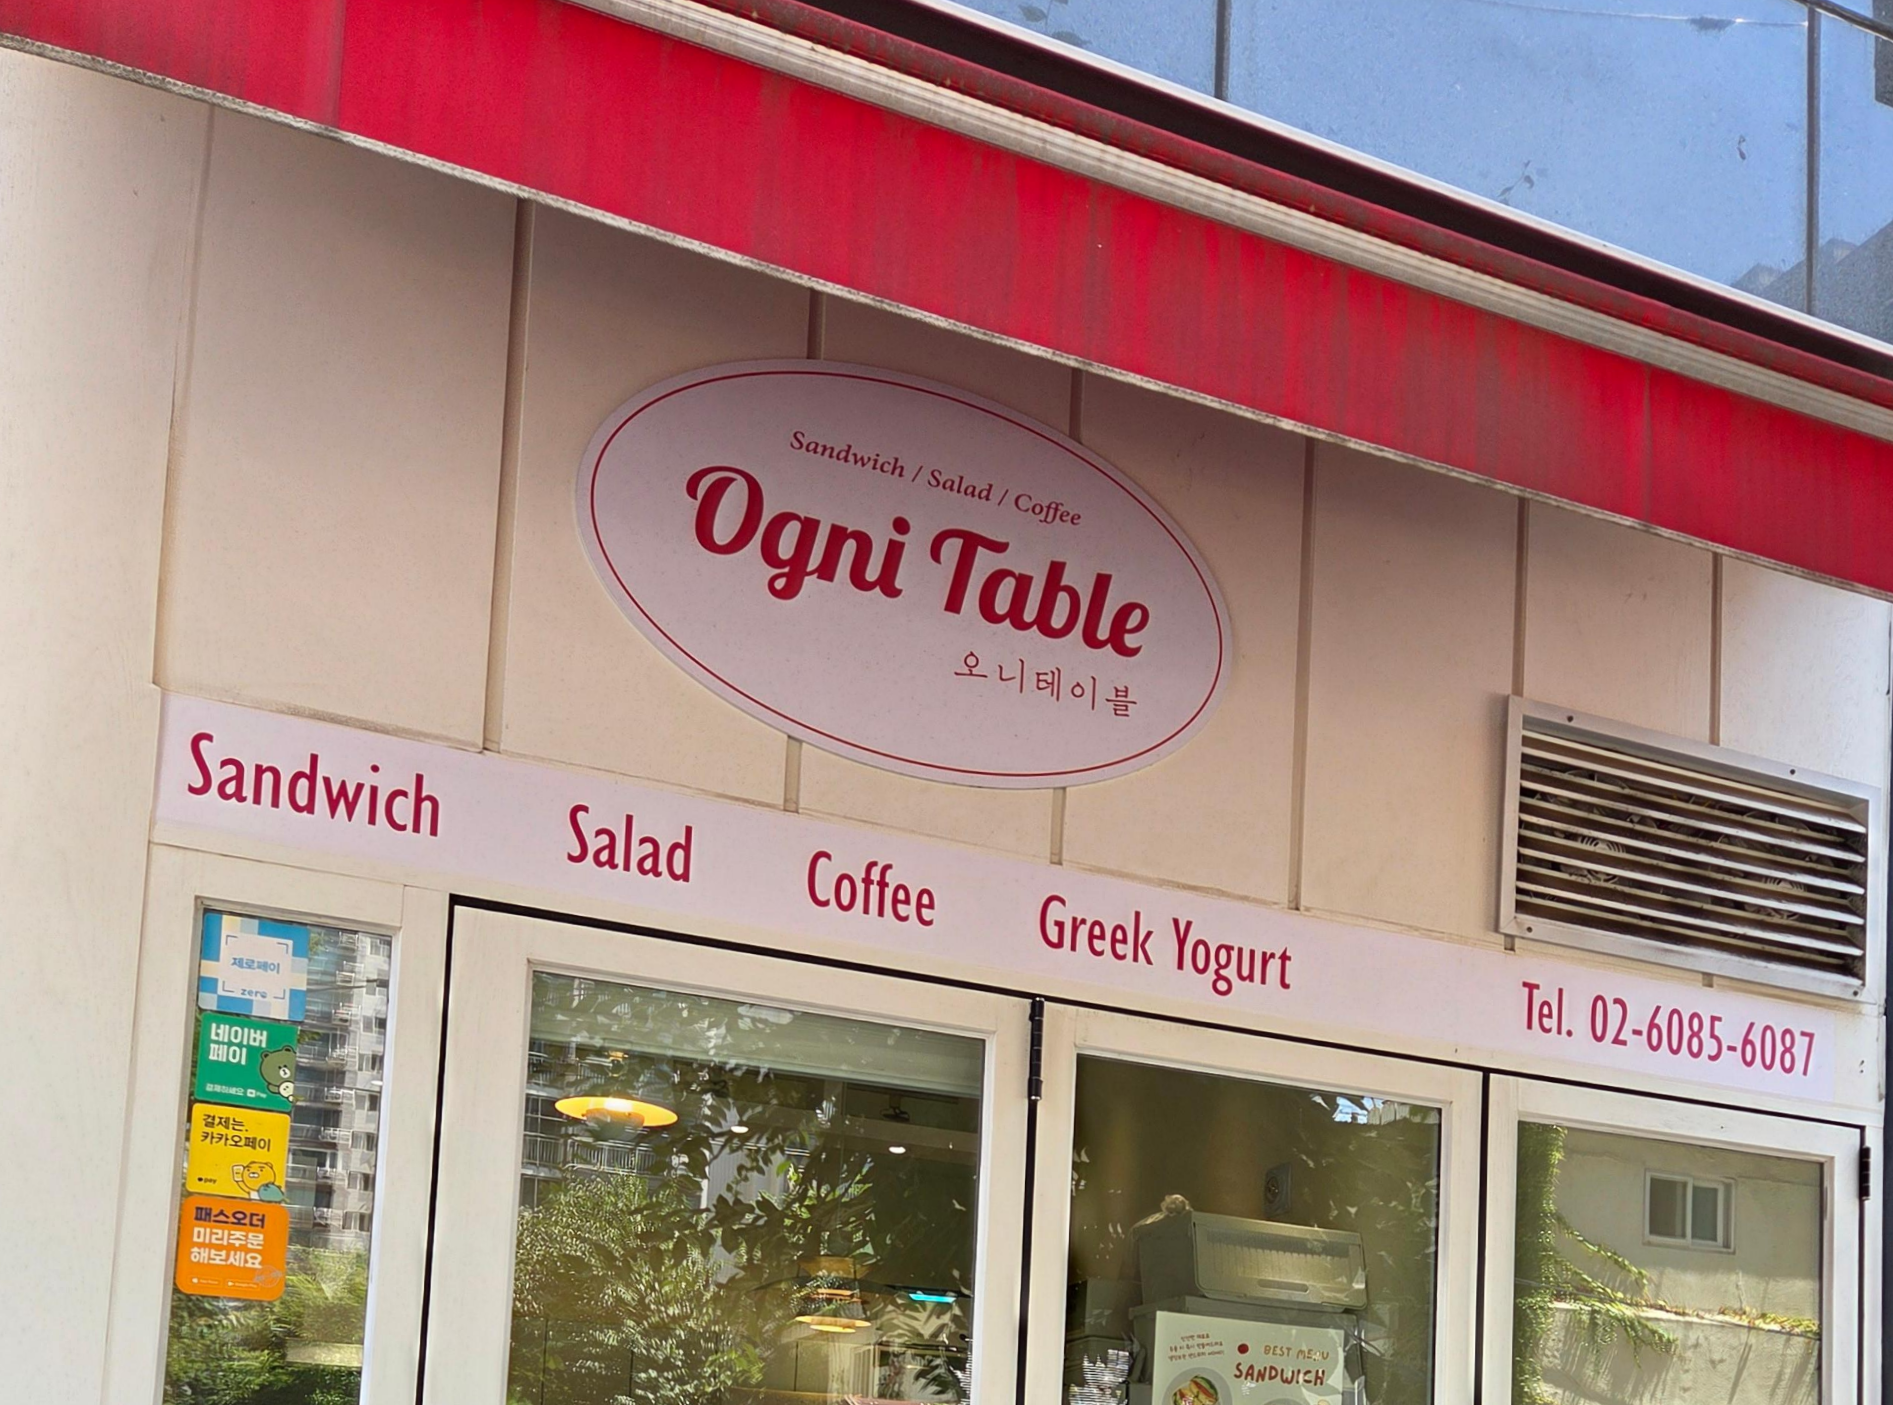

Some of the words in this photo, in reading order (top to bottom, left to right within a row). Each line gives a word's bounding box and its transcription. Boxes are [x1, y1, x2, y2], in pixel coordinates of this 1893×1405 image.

[790, 430, 906, 479] Sandwich
[927, 468, 993, 503] Salad
[1013, 493, 1082, 528] Coffee
[685, 465, 912, 600] Ogni
[929, 528, 1150, 658] Table
[953, 651, 1138, 718] 오니테이블
[186, 731, 440, 838] Sandwich
[566, 803, 694, 884] Salad
[806, 849, 936, 927] Coffee
[1038, 893, 1155, 966] Greek
[1171, 916, 1293, 997] Yogurt
[230, 956, 280, 975] 제로페이
[240, 987, 268, 999] zero
[210, 1022, 268, 1048] 네이버
[1521, 980, 1574, 1038] Tel.
[1589, 994, 1816, 1077] 02-6085-6087
[208, 1043, 247, 1066] 페이
[200, 1130, 271, 1153] 카카오페이
[193, 1205, 266, 1229] 패스오더
[192, 1226, 265, 1250] 미리주문
[189, 1247, 263, 1269] 해보세요
[1263, 1344, 1293, 1357] BEST
[1233, 1362, 1326, 1386] SANDWICH
